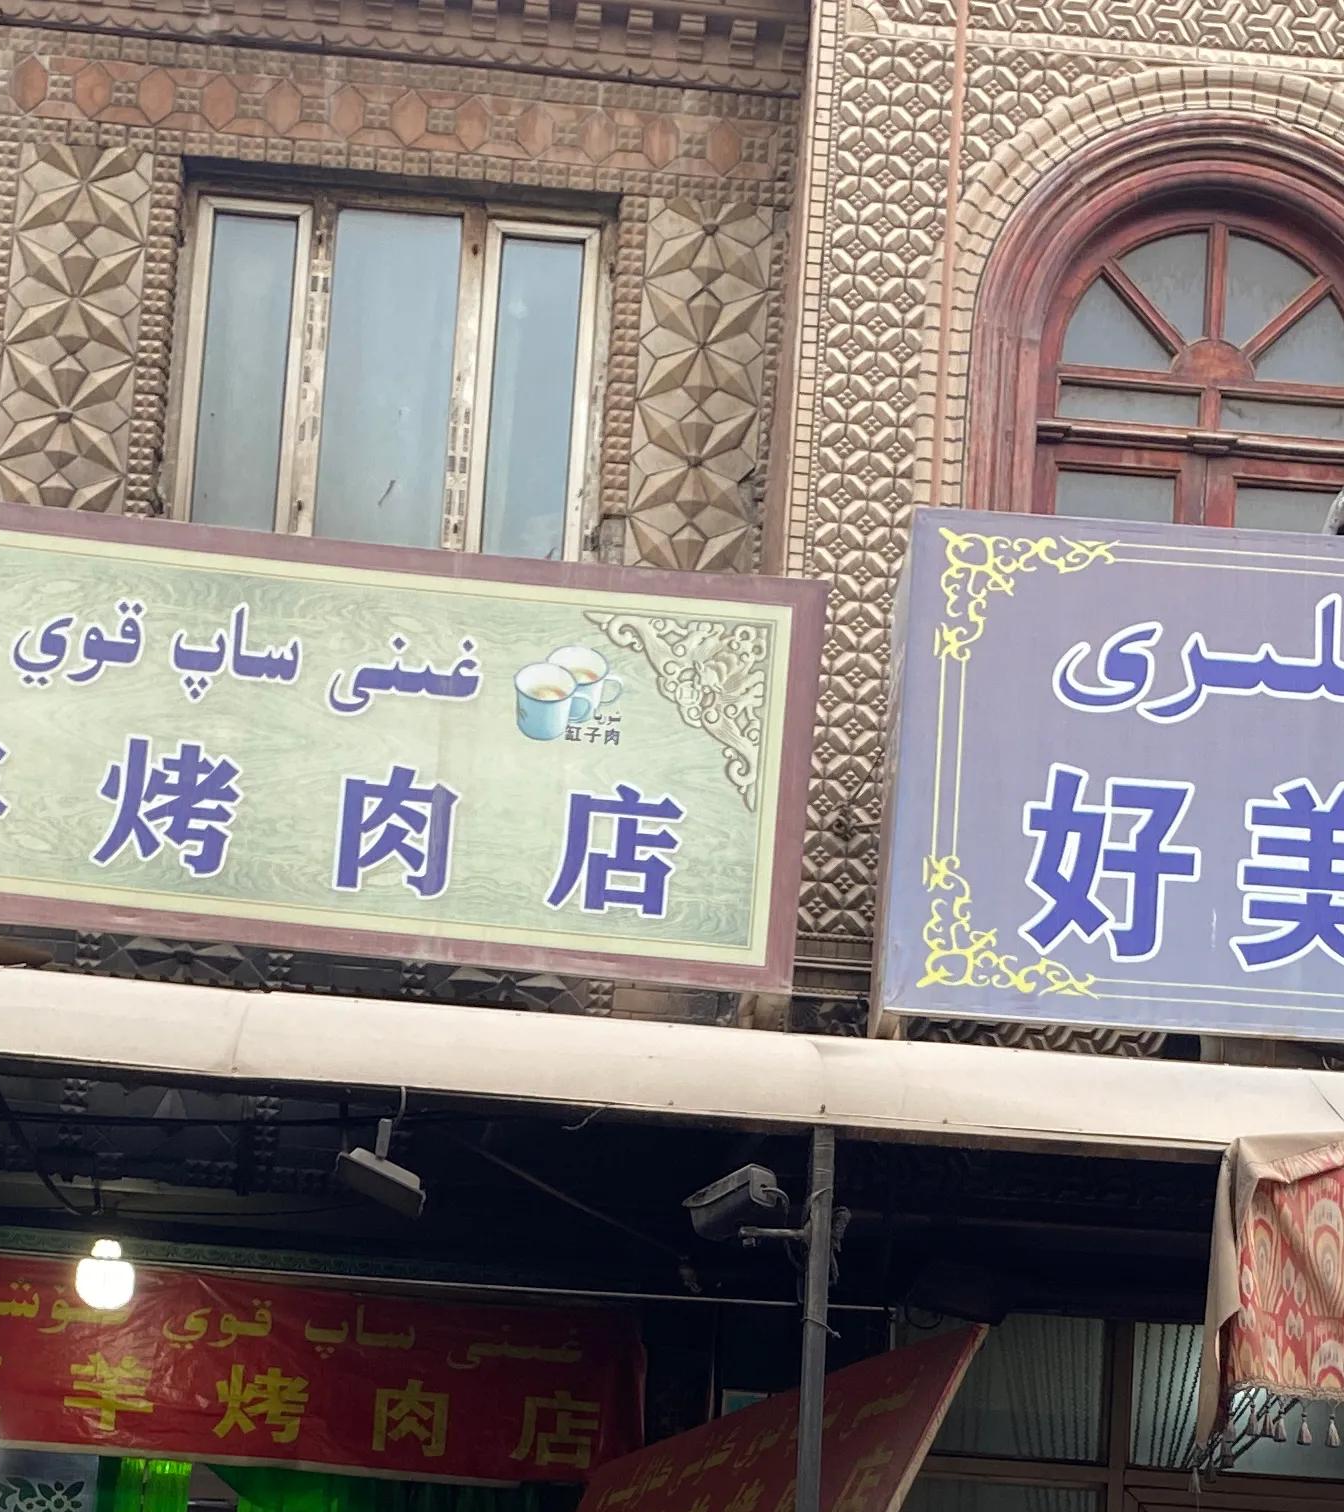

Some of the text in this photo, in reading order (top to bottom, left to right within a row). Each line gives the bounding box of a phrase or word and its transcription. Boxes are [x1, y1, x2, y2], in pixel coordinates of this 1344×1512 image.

[173, 605, 300, 701] ساپ
[564, 724, 621, 746] 缸子肉
